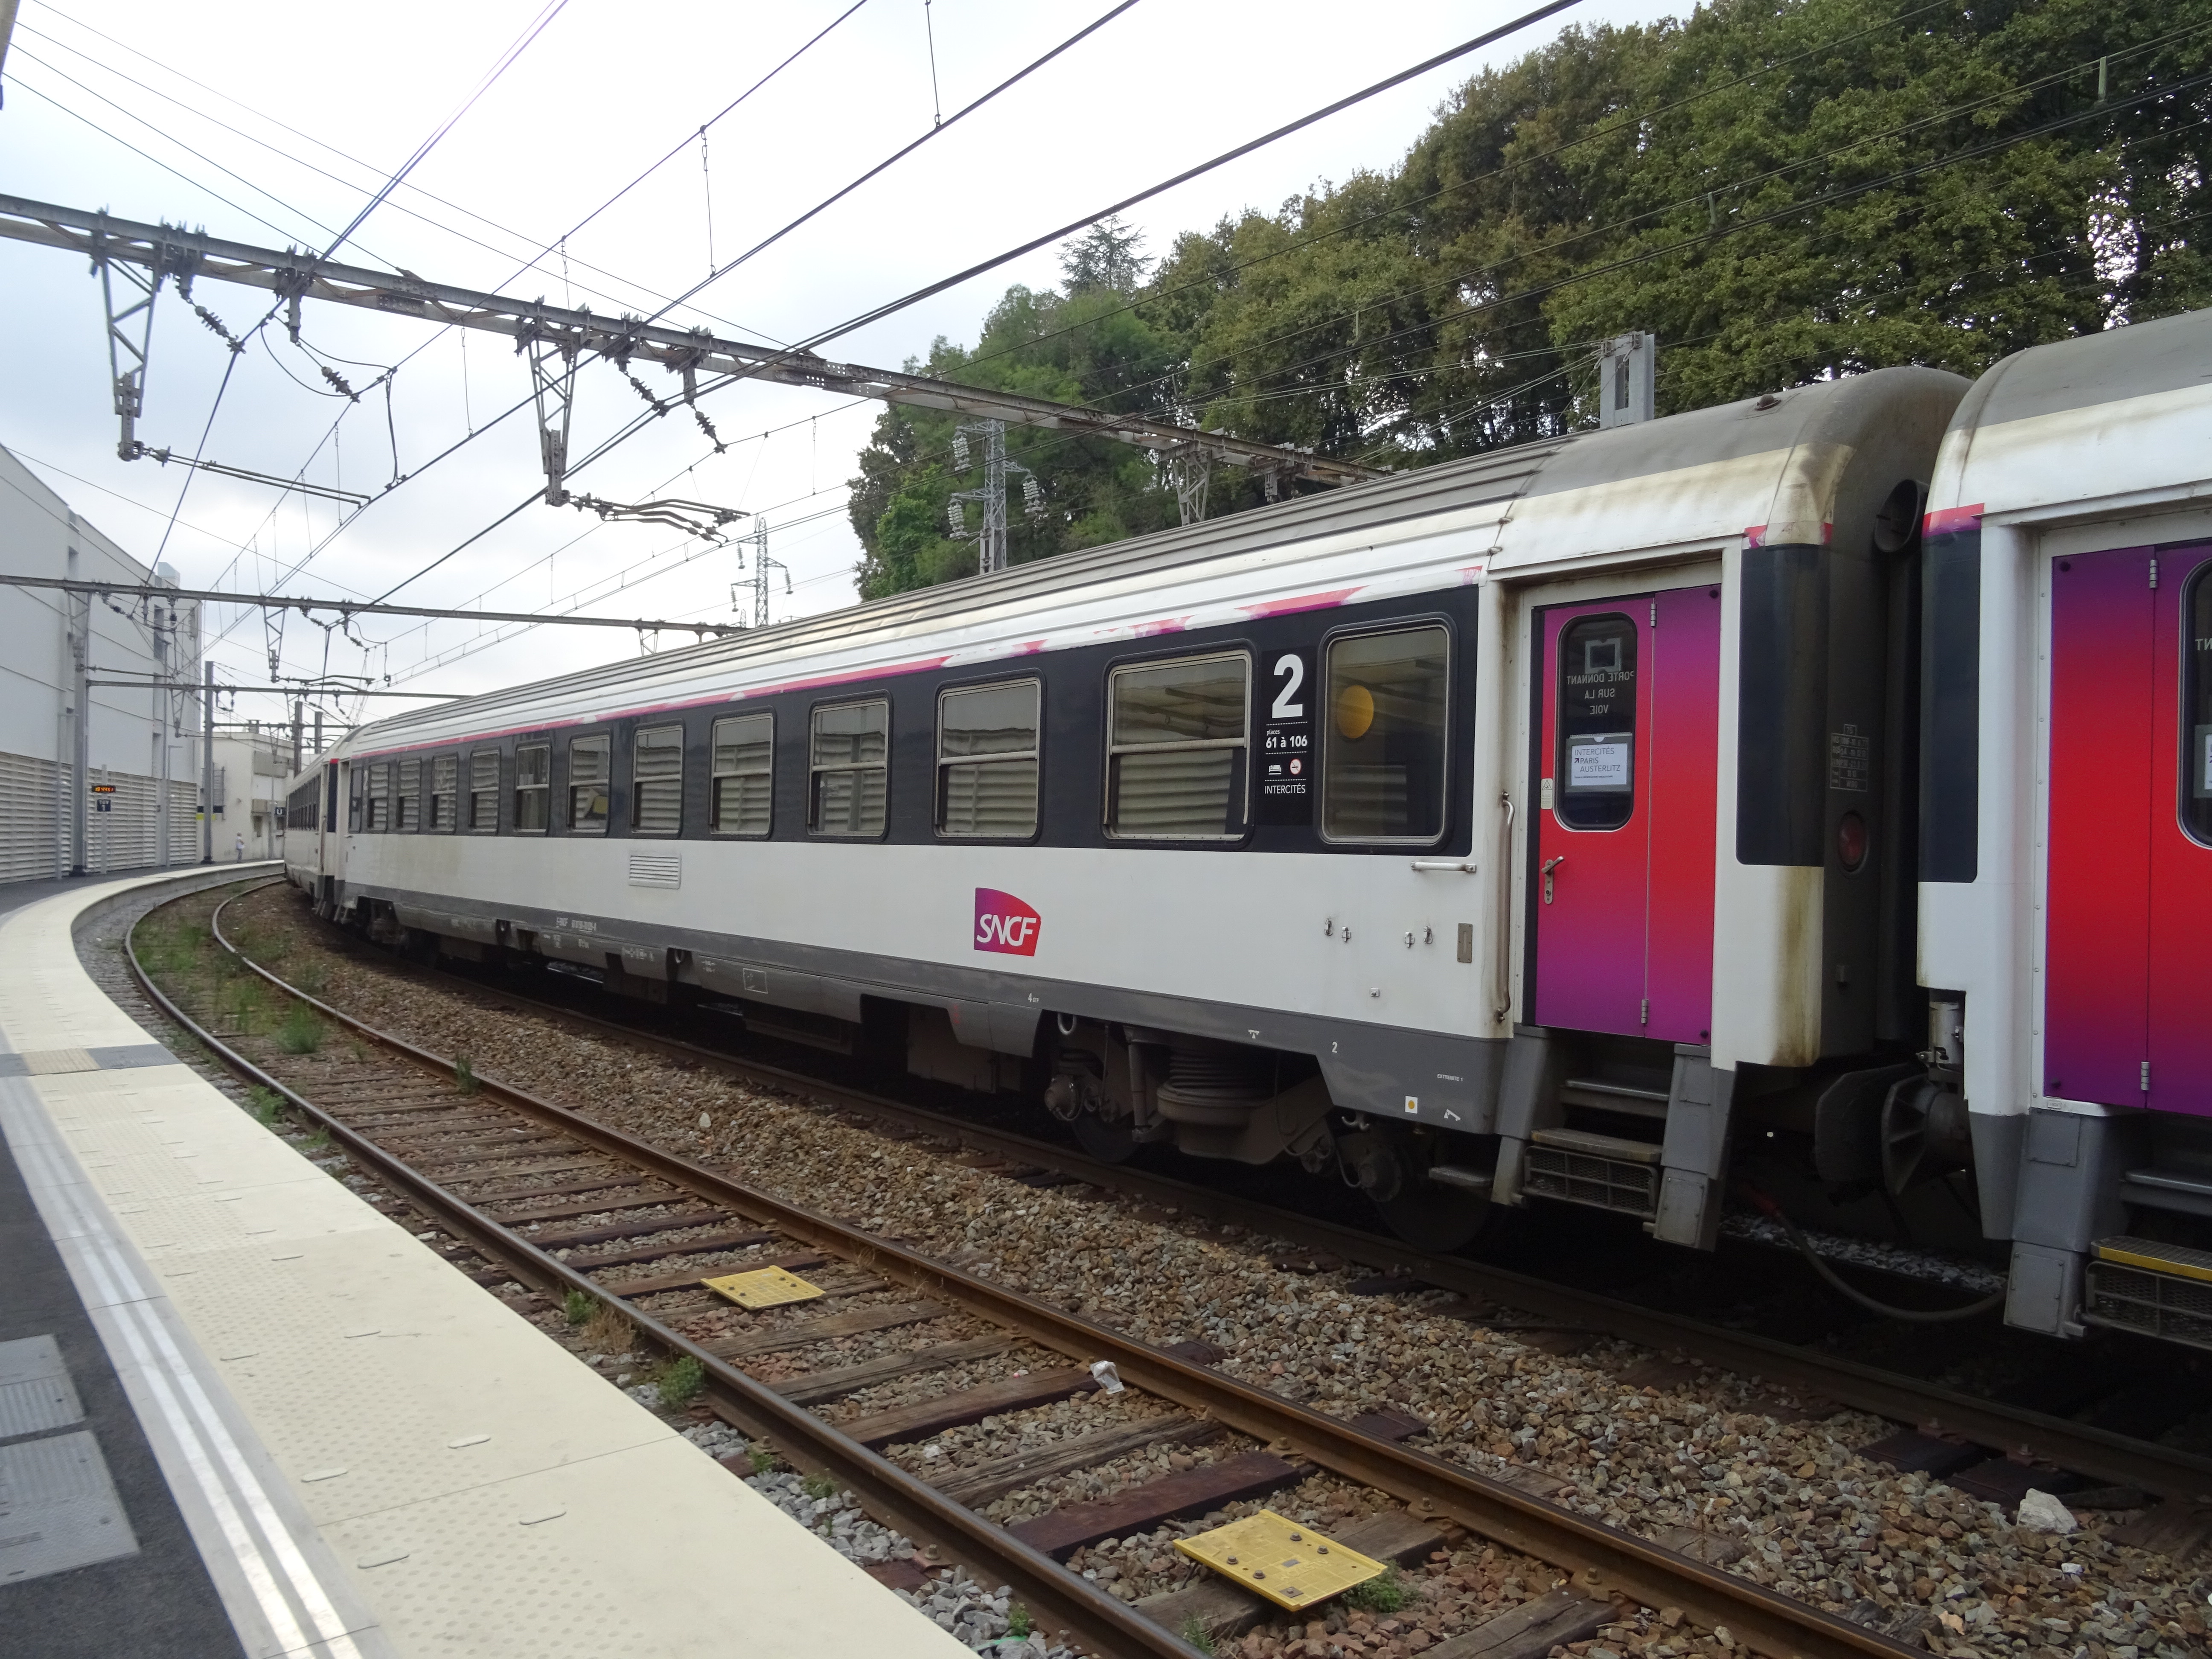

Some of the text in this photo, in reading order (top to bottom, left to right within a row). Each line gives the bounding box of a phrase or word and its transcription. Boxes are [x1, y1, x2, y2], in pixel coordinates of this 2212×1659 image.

[1272, 654, 1304, 719] 2
[1266, 735, 1307, 748] 61 à 106
[1575, 747, 1615, 756] INTERCITÉS
[1265, 783, 1306, 794] INTERCITÉS
[976, 914, 1037, 946] SNCF
[1332, 1042, 1338, 1053] 2
